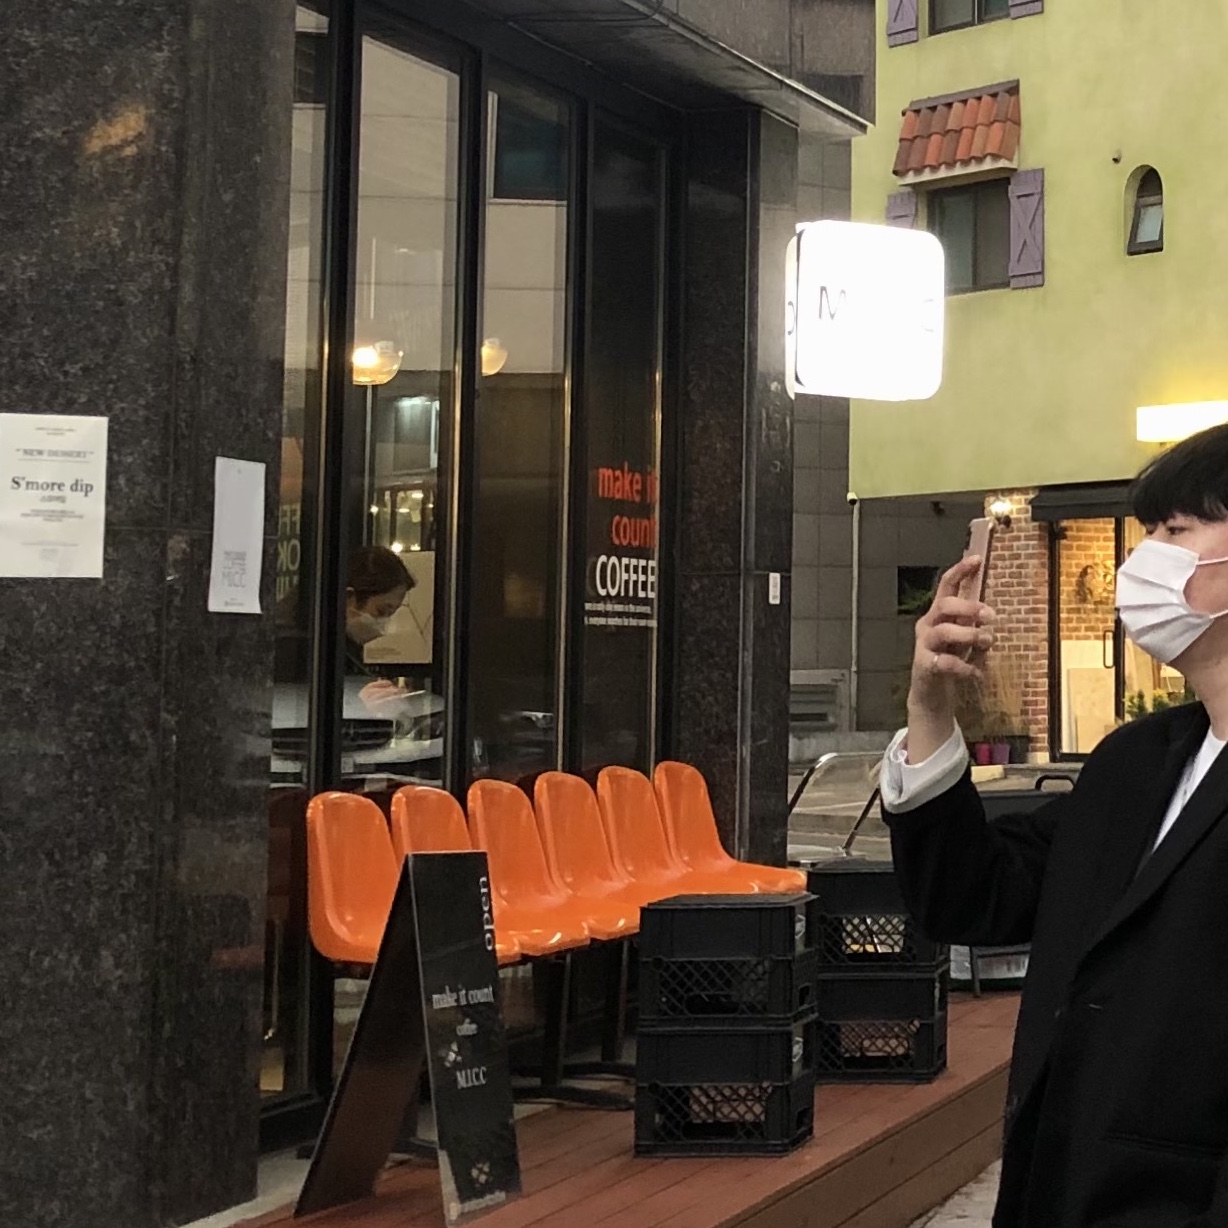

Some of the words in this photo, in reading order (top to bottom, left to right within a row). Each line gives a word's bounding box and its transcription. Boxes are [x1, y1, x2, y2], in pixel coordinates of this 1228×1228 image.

[70, 479, 94, 497] dip
[598, 461, 642, 503] make
[595, 554, 656, 598] COFFEE
[458, 984, 467, 1006] it
